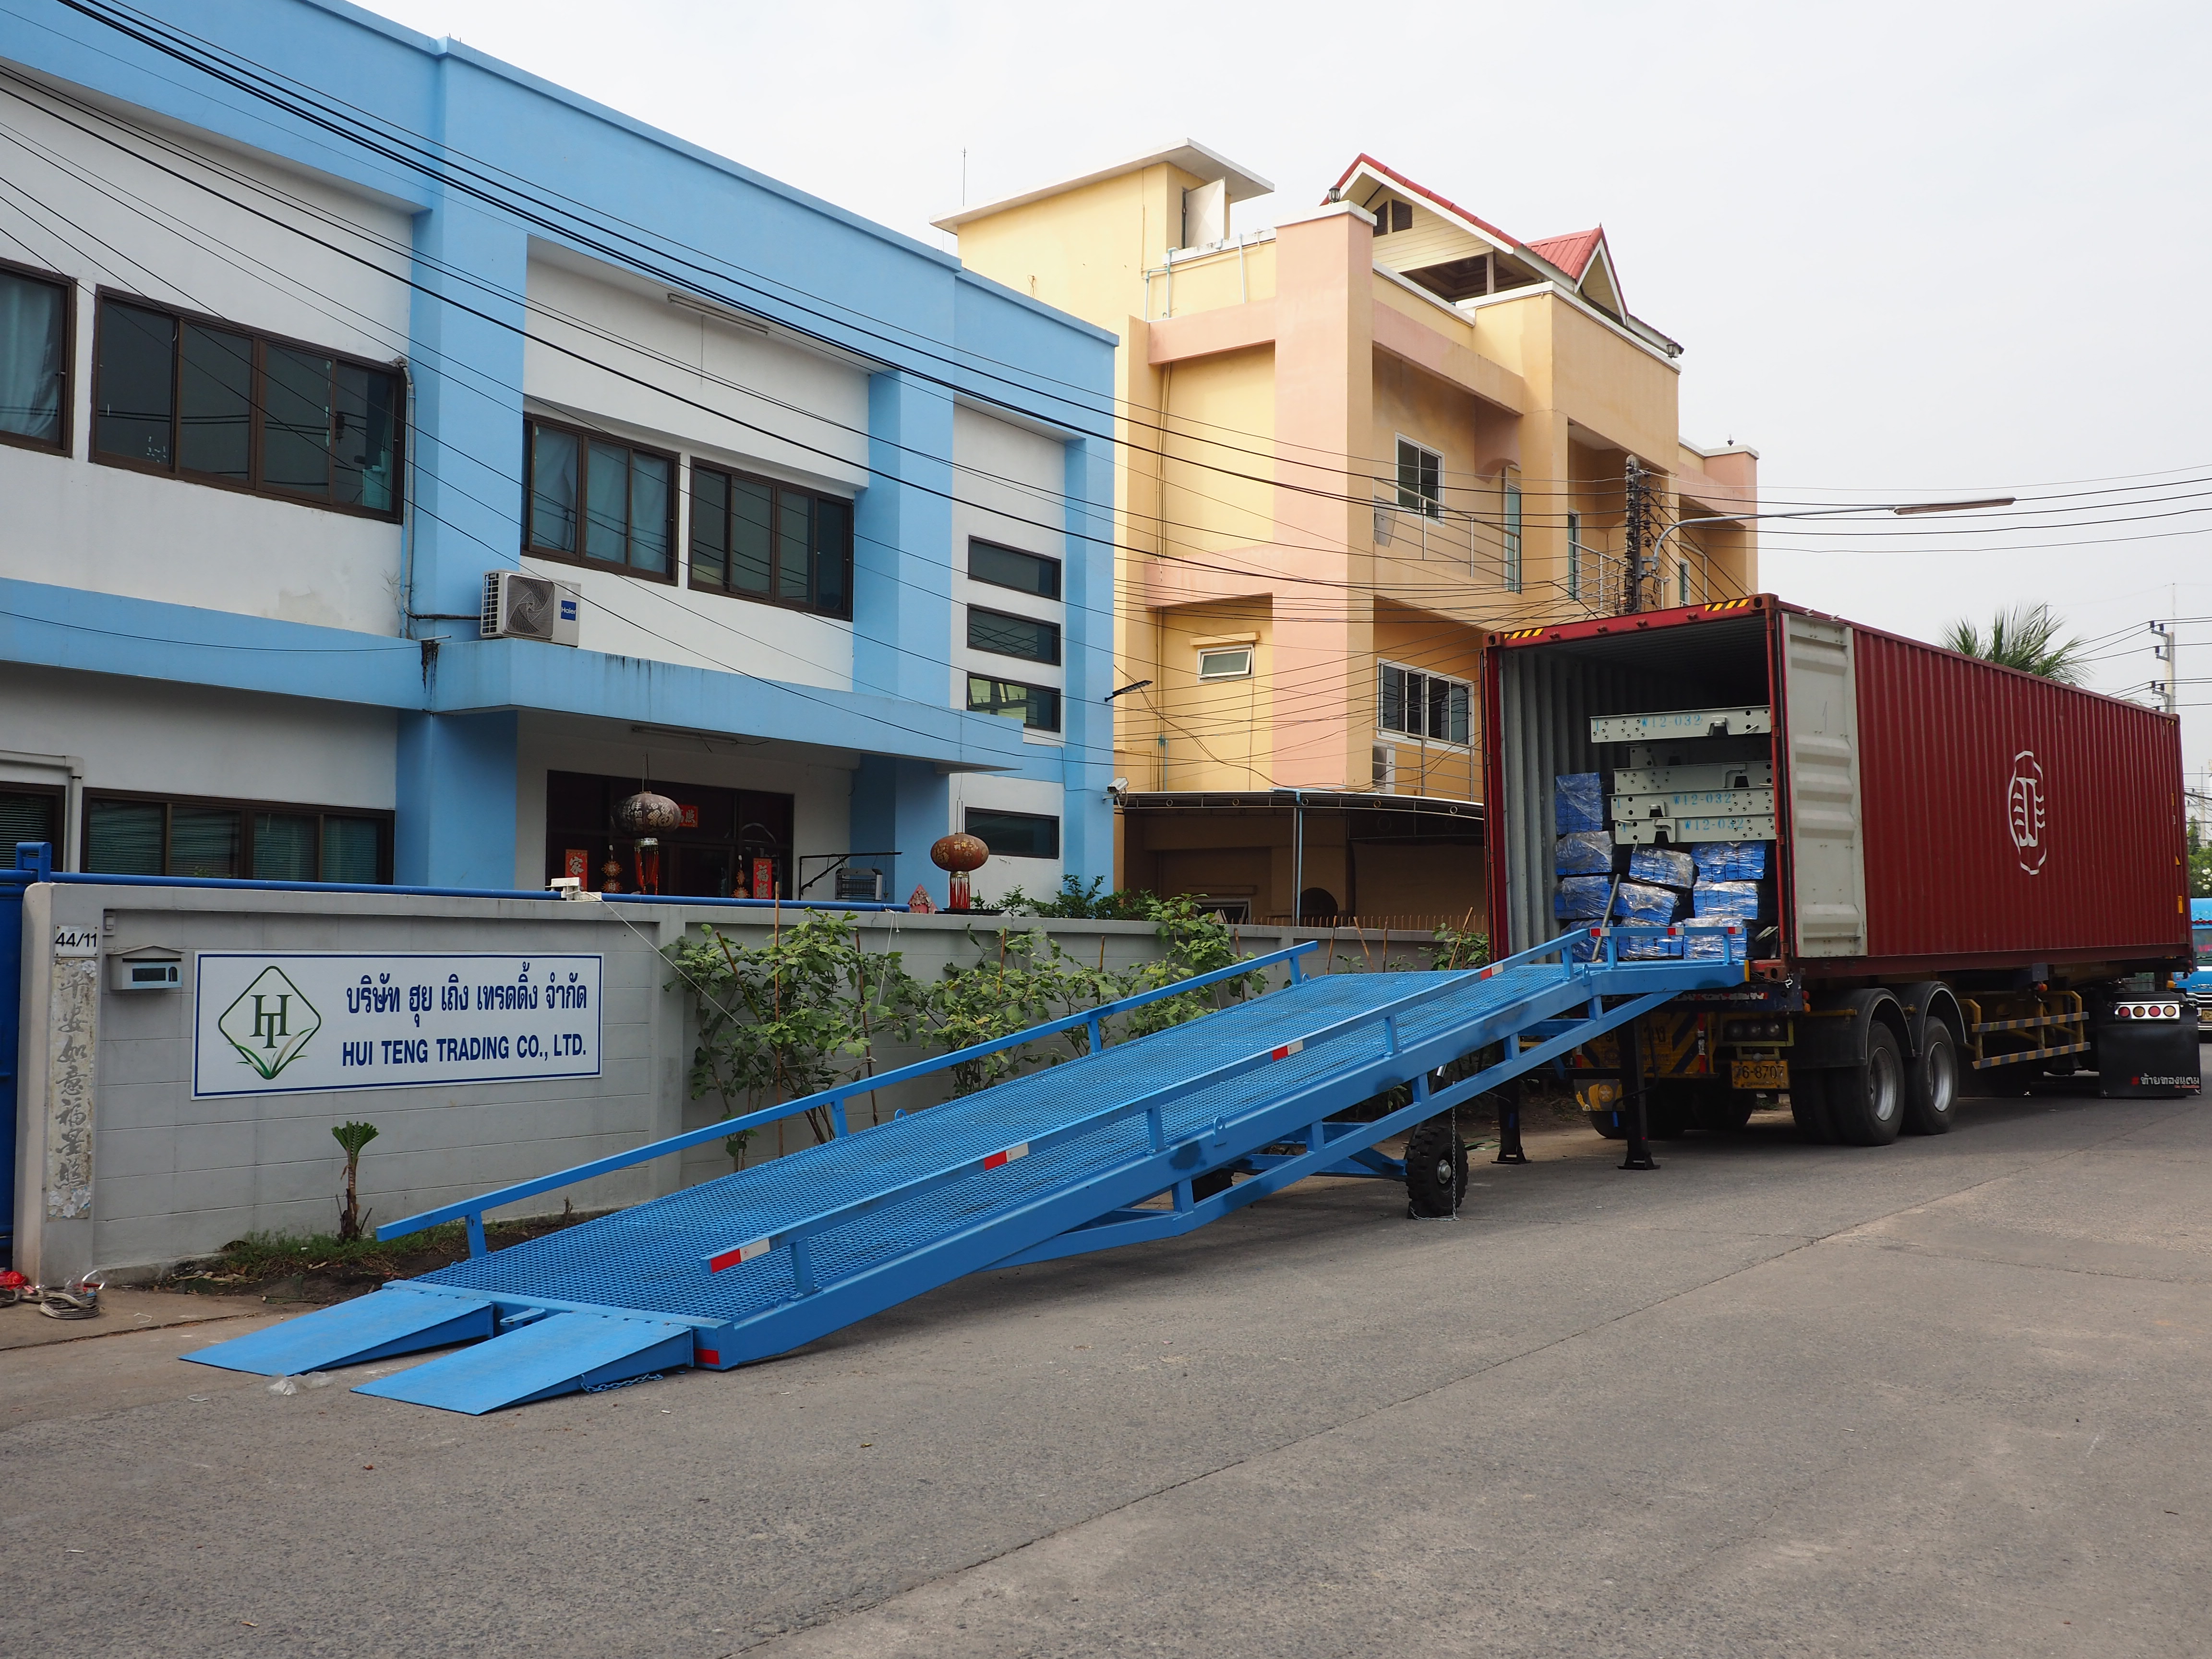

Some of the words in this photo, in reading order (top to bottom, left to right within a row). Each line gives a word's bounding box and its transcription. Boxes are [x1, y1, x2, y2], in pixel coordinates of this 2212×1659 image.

[1641, 715, 1701, 728] W12-032
[1673, 793, 1731, 805] W12-032
[1684, 817, 1743, 830] W12-032
[55, 932, 97, 948] 44/11
[347, 973, 400, 1013] บริษัท
[409, 985, 432, 1027] ฮุย
[442, 974, 469, 1011] เถิง
[477, 962, 538, 1010] เทรดดิ้ง
[546, 972, 587, 1009] จำกัด
[342, 1041, 373, 1066] HUI
[381, 1039, 428, 1065] TENG
[436, 1035, 509, 1062] TRADING
[517, 1034, 548, 1061] CO.,
[553, 1033, 586, 1057] LTD.
